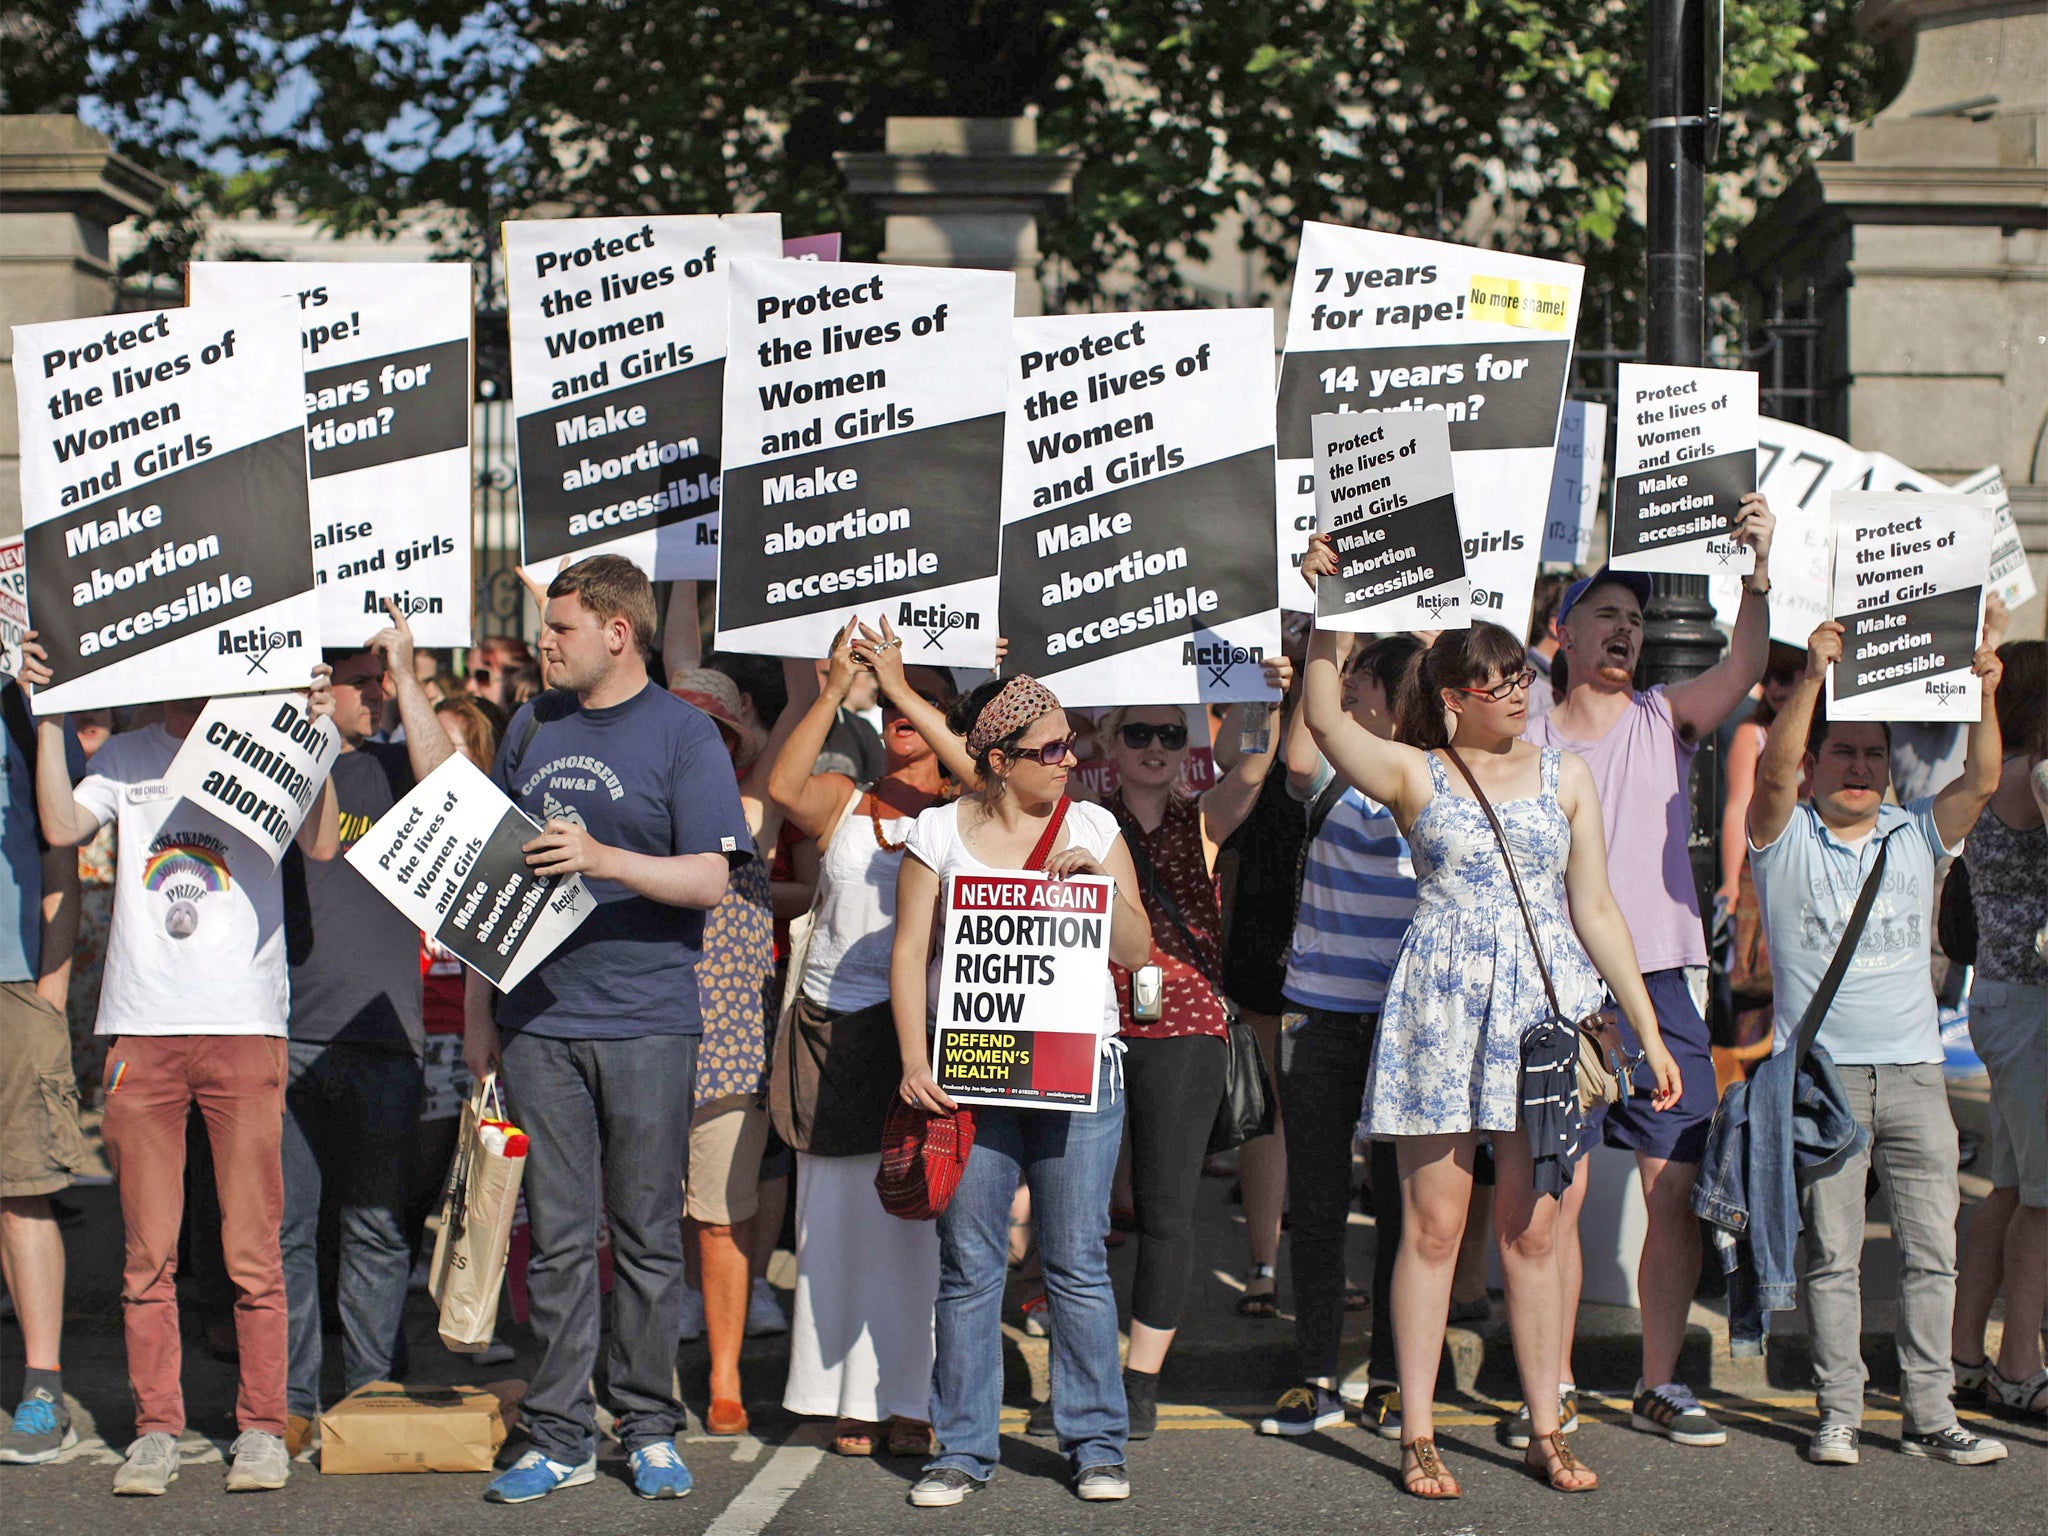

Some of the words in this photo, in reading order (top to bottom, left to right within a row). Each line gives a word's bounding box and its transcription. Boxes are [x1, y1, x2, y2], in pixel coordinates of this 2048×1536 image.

[536, 224, 655, 278] Protect
[541, 282, 593, 318] the
[602, 267, 674, 301] lives
[684, 246, 717, 278] of
[757, 276, 884, 324] Protect
[1315, 268, 1334, 292] 7
[1344, 265, 1437, 297] years
[1471, 288, 1486, 305] No
[1490, 294, 1519, 309] more
[1311, 304, 1363, 330] for
[1376, 295, 1465, 329] rape!
[43, 313, 170, 378] Protect
[545, 311, 664, 358] Women
[758, 336, 811, 368] the
[823, 317, 901, 355] lives
[912, 305, 948, 336] of
[1021, 321, 1146, 379] Protect
[48, 385, 103, 421] the
[113, 355, 191, 399] lives
[200, 330, 236, 366] of
[305, 379, 370, 413] ears
[379, 363, 431, 395] for
[551, 357, 608, 400] and
[620, 342, 694, 379] Girls
[758, 366, 886, 411] Women
[1024, 386, 1078, 421] the
[1088, 364, 1165, 402] lives
[1176, 343, 1211, 375] of
[1319, 366, 1359, 394] 14
[1369, 361, 1464, 397] years
[1476, 353, 1528, 381] for
[1636, 380, 1698, 403] Protect
[1637, 409, 1664, 426] the
[1669, 401, 1707, 419] lives
[1711, 394, 1728, 411] of
[53, 402, 180, 463] Women
[308, 406, 394, 451] tion?
[556, 404, 648, 447] Make
[761, 419, 822, 456] and
[834, 404, 915, 439] Girls
[1027, 410, 1154, 464] Women
[1328, 426, 1384, 457] Protect
[1638, 424, 1701, 448] Women
[60, 460, 122, 507] and
[133, 431, 213, 478] Girls
[562, 435, 699, 492] abortion
[1033, 465, 1093, 507] and
[1105, 444, 1184, 484] Girls
[1329, 461, 1353, 480] the
[1358, 451, 1394, 471] lives
[1400, 439, 1416, 457] of
[1638, 450, 1670, 470] and
[1676, 443, 1715, 462] Girls
[569, 473, 720, 536] accessible
[763, 467, 858, 507] Make
[1331, 476, 1391, 503] Women
[1638, 474, 1688, 495] Make
[1334, 505, 1363, 527] and
[1369, 494, 1408, 514] Girls
[1638, 492, 1715, 520] abortion
[66, 504, 163, 557] Make
[764, 505, 910, 555] abortion
[1037, 511, 1132, 557] Make
[1337, 527, 1386, 553] Make
[1464, 530, 1524, 559] girls
[1638, 513, 1727, 544] accessible
[1706, 540, 1747, 555] Action
[1855, 516, 1923, 542] Protect
[1856, 546, 1885, 565] the
[1890, 537, 1932, 559] lives
[1936, 531, 1956, 549] of
[72, 533, 220, 607] abortion
[337, 549, 385, 579] and
[395, 535, 454, 570] girls
[766, 548, 938, 604] accessible
[1041, 544, 1187, 606] abortion
[1342, 545, 1416, 579] abortion
[1856, 564, 1924, 587] Women
[1345, 566, 1434, 604] accessible
[1417, 594, 1460, 609] Action
[1856, 591, 1889, 610] and
[1896, 582, 1937, 601] Girls
[78, 573, 253, 657] accessible
[898, 602, 979, 629] Action
[1046, 586, 1218, 656] accessible
[1856, 613, 1907, 636] Make
[218, 626, 302, 655] Action
[1183, 640, 1263, 665] Action
[1856, 630, 1932, 661] abortion
[1857, 653, 1945, 686] accessible
[1925, 681, 1966, 695] Action
[271, 702, 329, 764] Don't
[549, 777, 597, 791] NW&B
[378, 805, 424, 871] Protect
[397, 857, 419, 886] the
[417, 820, 444, 856] lives
[444, 791, 459, 813] of
[413, 835, 458, 900] Women
[434, 880, 458, 915] and
[454, 837, 483, 877] Girls
[165, 884, 207, 903] PRIDE
[452, 881, 489, 930] Make
[476, 873, 523, 943] abortion
[551, 884, 580, 915] Action
[961, 883, 1027, 906] NEVER
[1030, 884, 1097, 909] AGAIN
[497, 876, 549, 956] accessible
[955, 915, 1102, 949] ABORTION
[955, 954, 1056, 985] RIGHTS
[952, 992, 1026, 1023] NOW
[945, 1049, 1030, 1064] WOMEN'S
[946, 1033, 1015, 1048] DEFEND
[945, 1065, 1010, 1080] HEALTH
